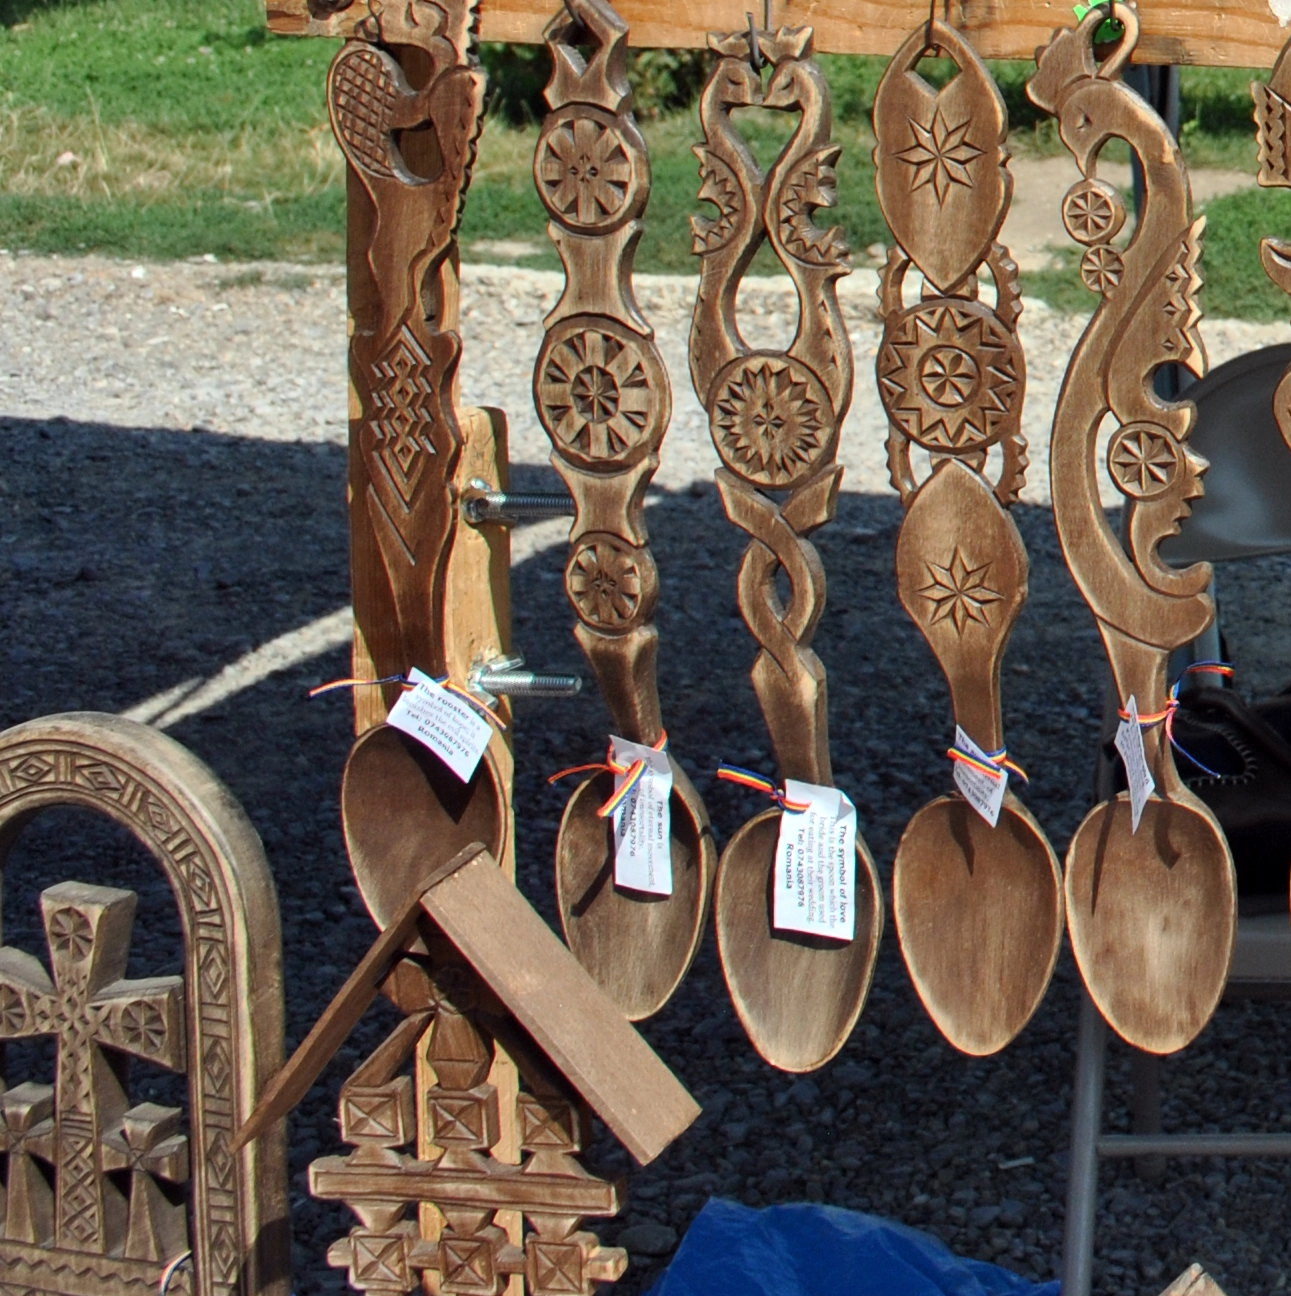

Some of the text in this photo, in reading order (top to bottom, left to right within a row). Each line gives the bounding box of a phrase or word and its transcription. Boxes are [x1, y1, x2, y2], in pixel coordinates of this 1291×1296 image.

[419, 684, 436, 698] The
[437, 696, 469, 719] rooster
[417, 726, 454, 756] Romania
[424, 718, 470, 758] 0743087976
[785, 843, 794, 889] Romania
[818, 841, 826, 859] and
[828, 845, 836, 859] the
[796, 848, 806, 908] 0743087976
[837, 825, 848, 923] The symbol of love
[819, 905, 827, 924] used
